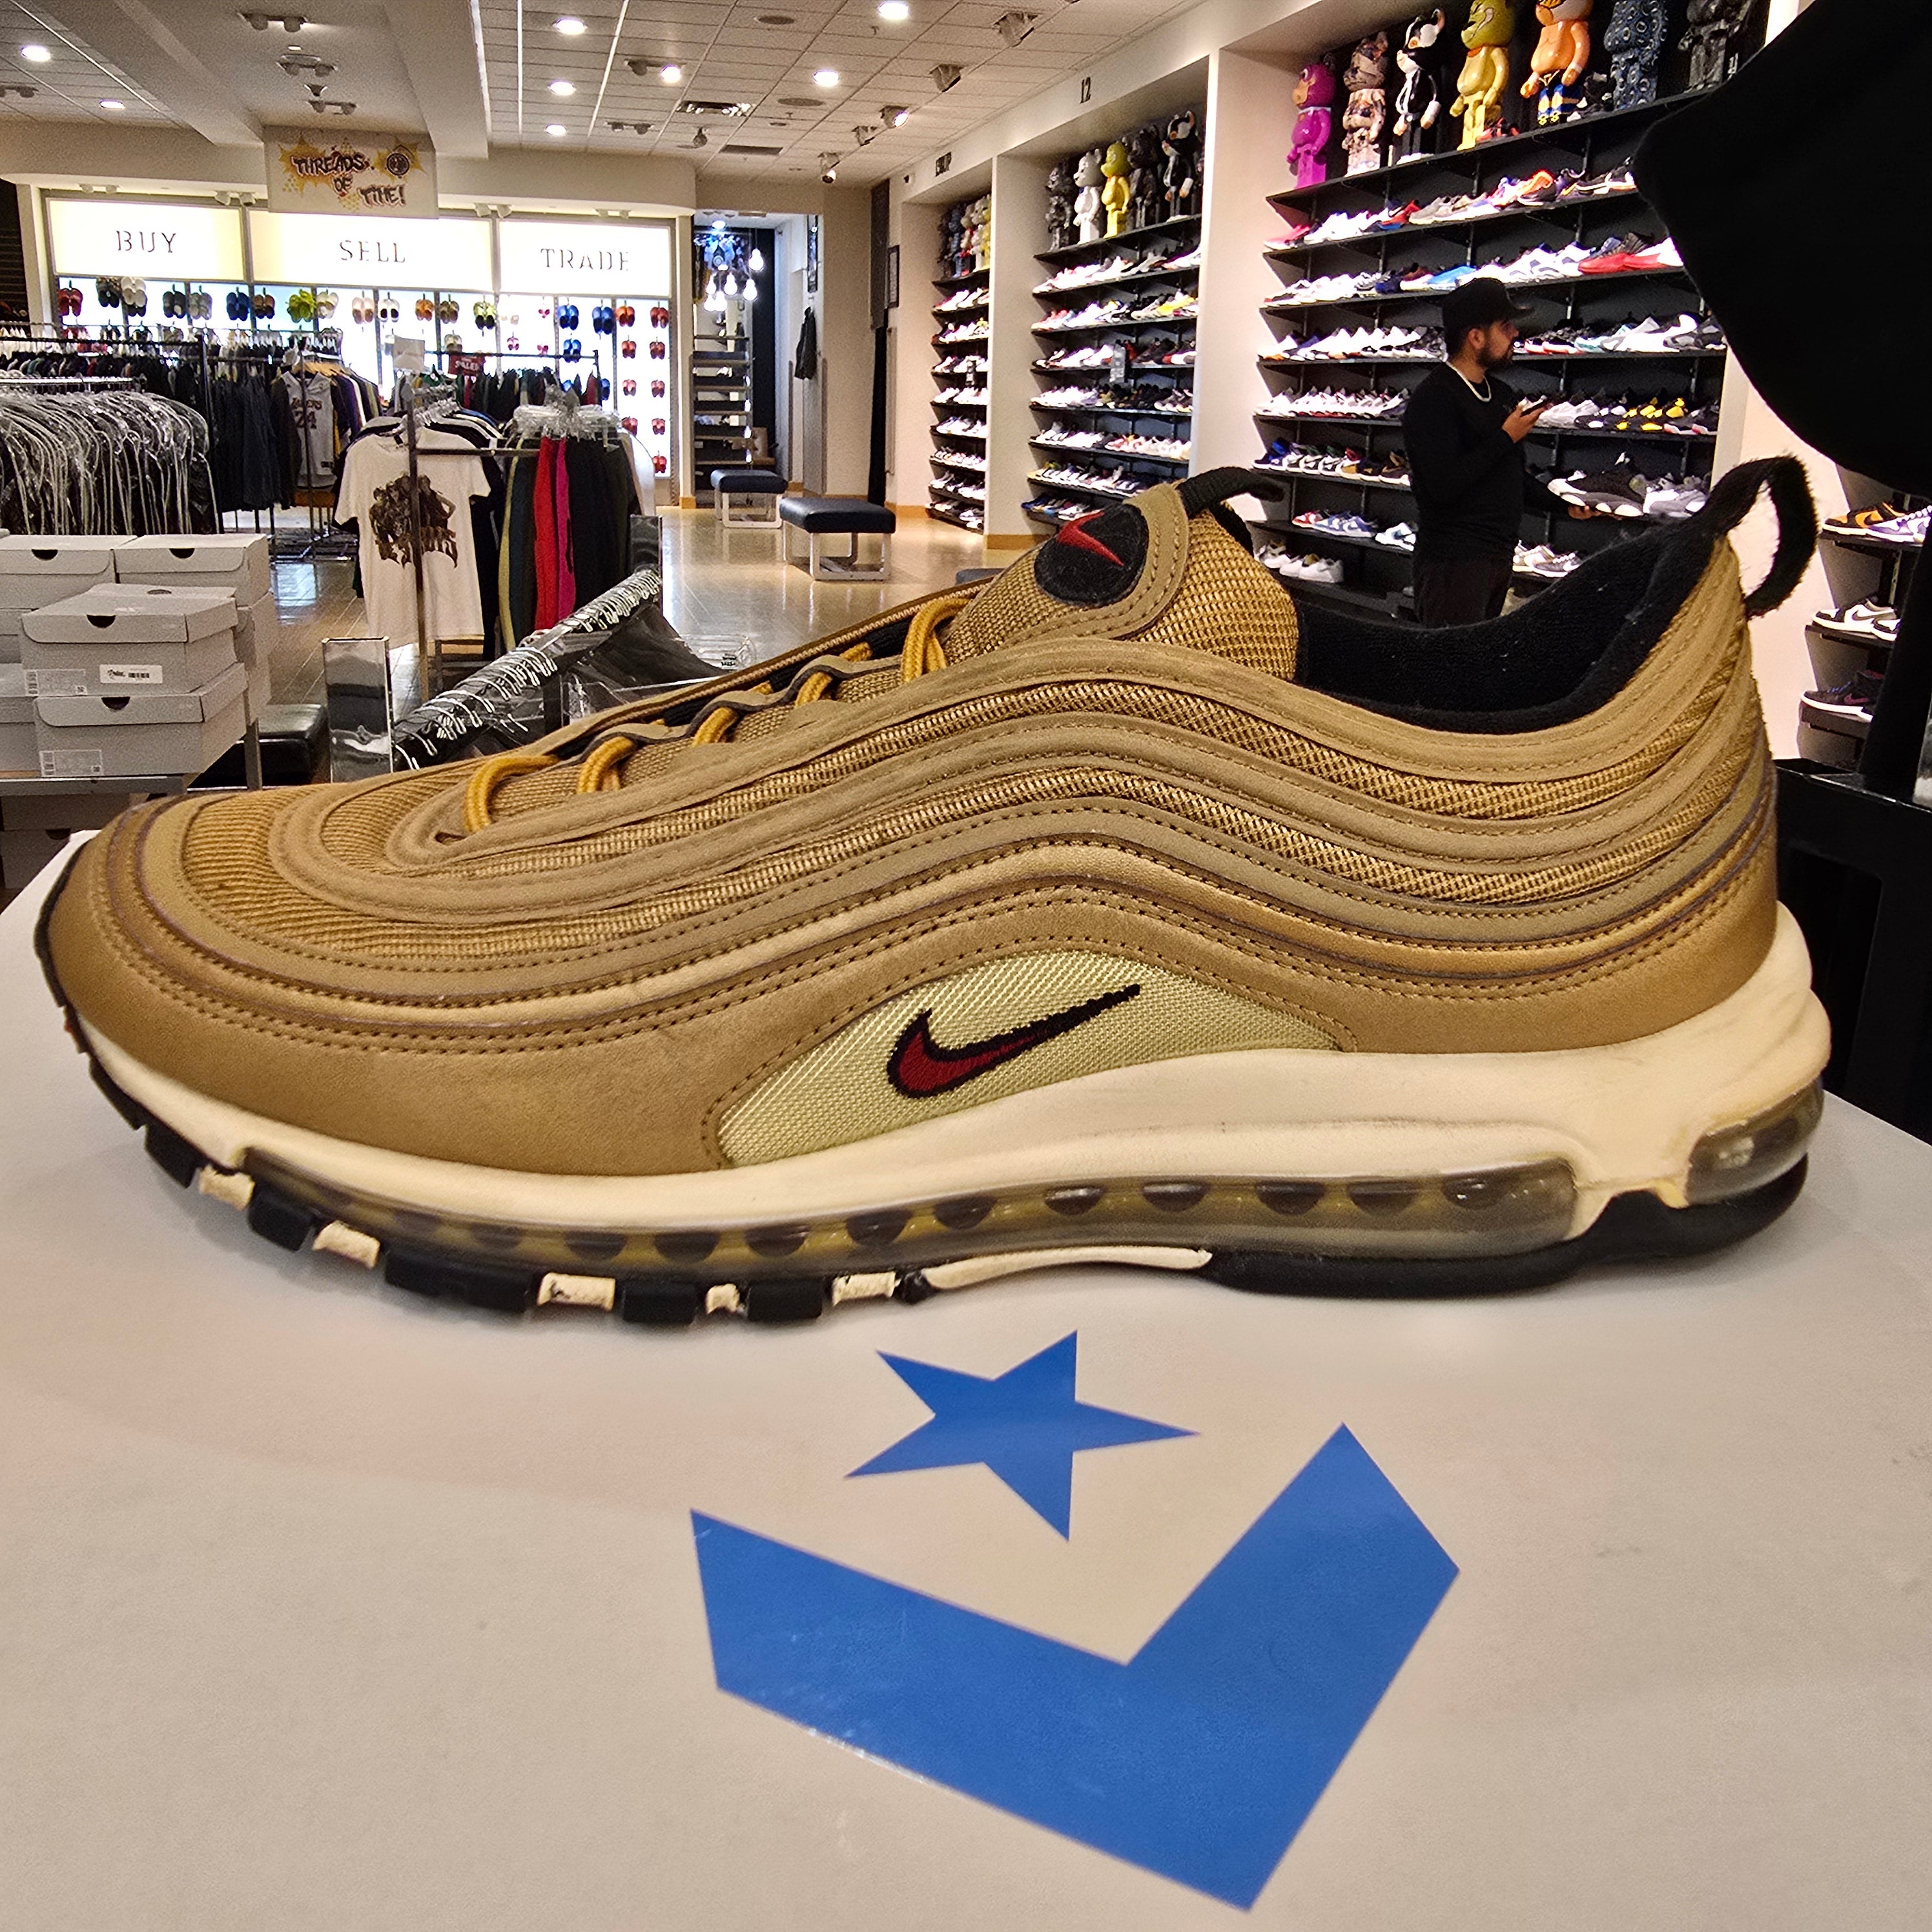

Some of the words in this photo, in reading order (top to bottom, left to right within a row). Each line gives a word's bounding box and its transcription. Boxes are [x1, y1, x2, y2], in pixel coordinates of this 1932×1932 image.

[292, 151, 366, 176] THREADS
[333, 174, 353, 194] OF
[116, 231, 176, 252] BUY
[340, 240, 405, 263] SELL
[540, 248, 628, 271] TRADE
